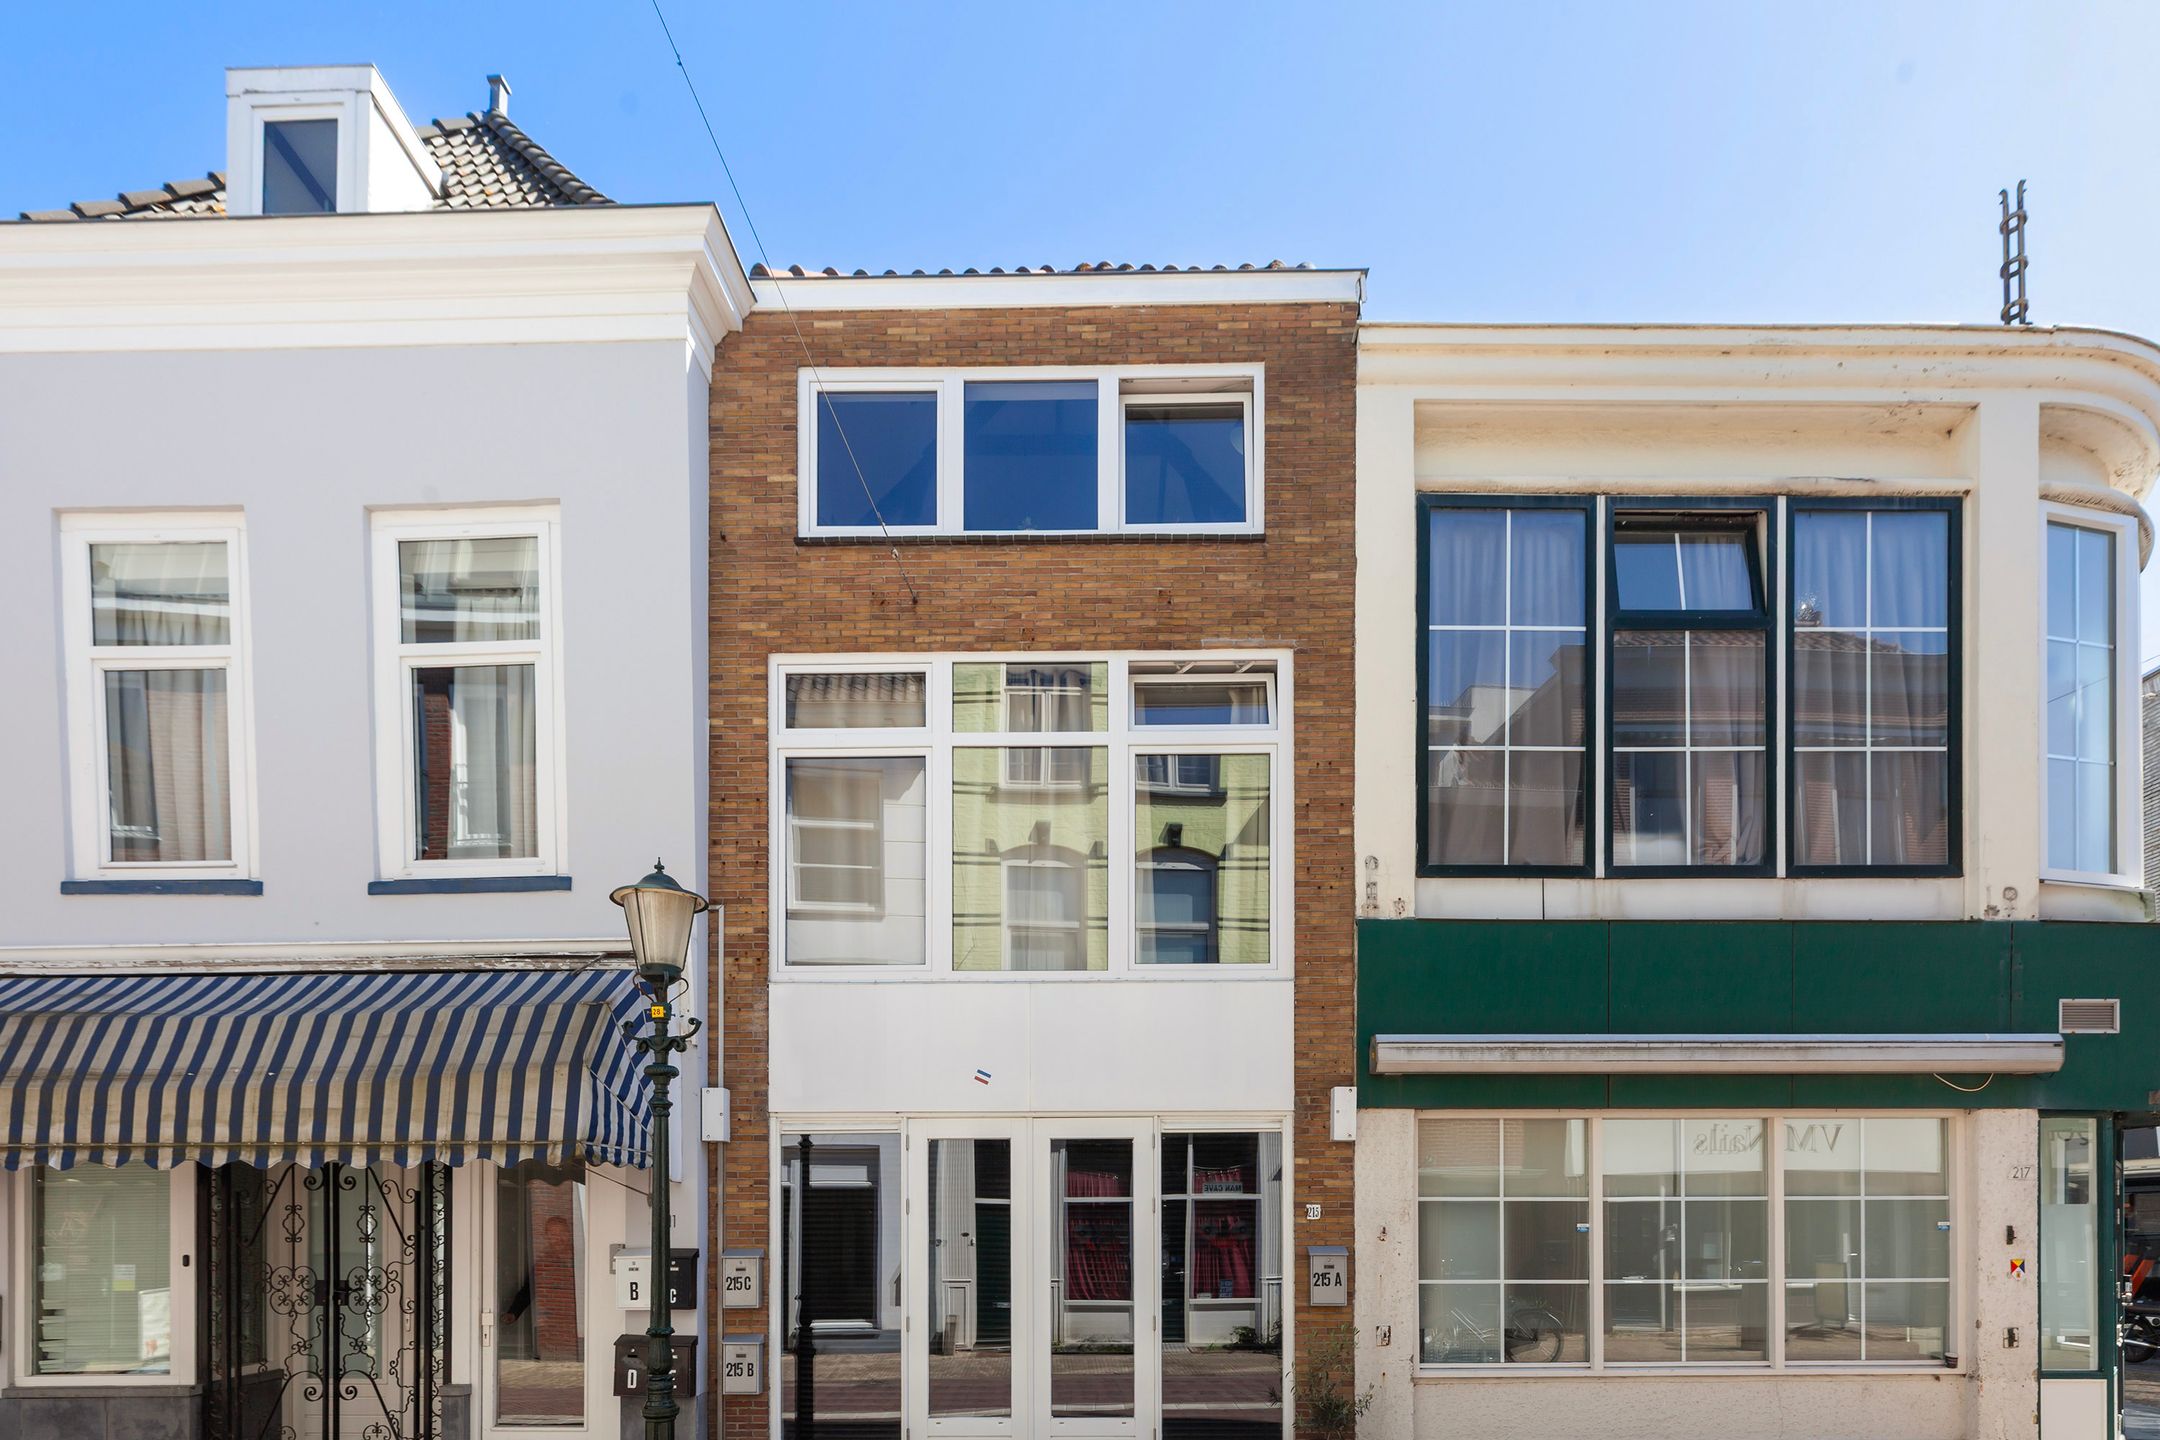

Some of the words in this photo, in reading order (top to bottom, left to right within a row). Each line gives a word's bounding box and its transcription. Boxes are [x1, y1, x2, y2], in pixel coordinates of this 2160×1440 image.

[2012, 1166, 2031, 1179] 217
[1308, 1206, 1320, 1218] 215
[1313, 1272, 1331, 1287] 215
[1334, 1272, 1342, 1287] A
[629, 1281, 639, 1301] B
[669, 1288, 677, 1304] C
[726, 1362, 743, 1377] 215
[747, 1362, 754, 1377] B
